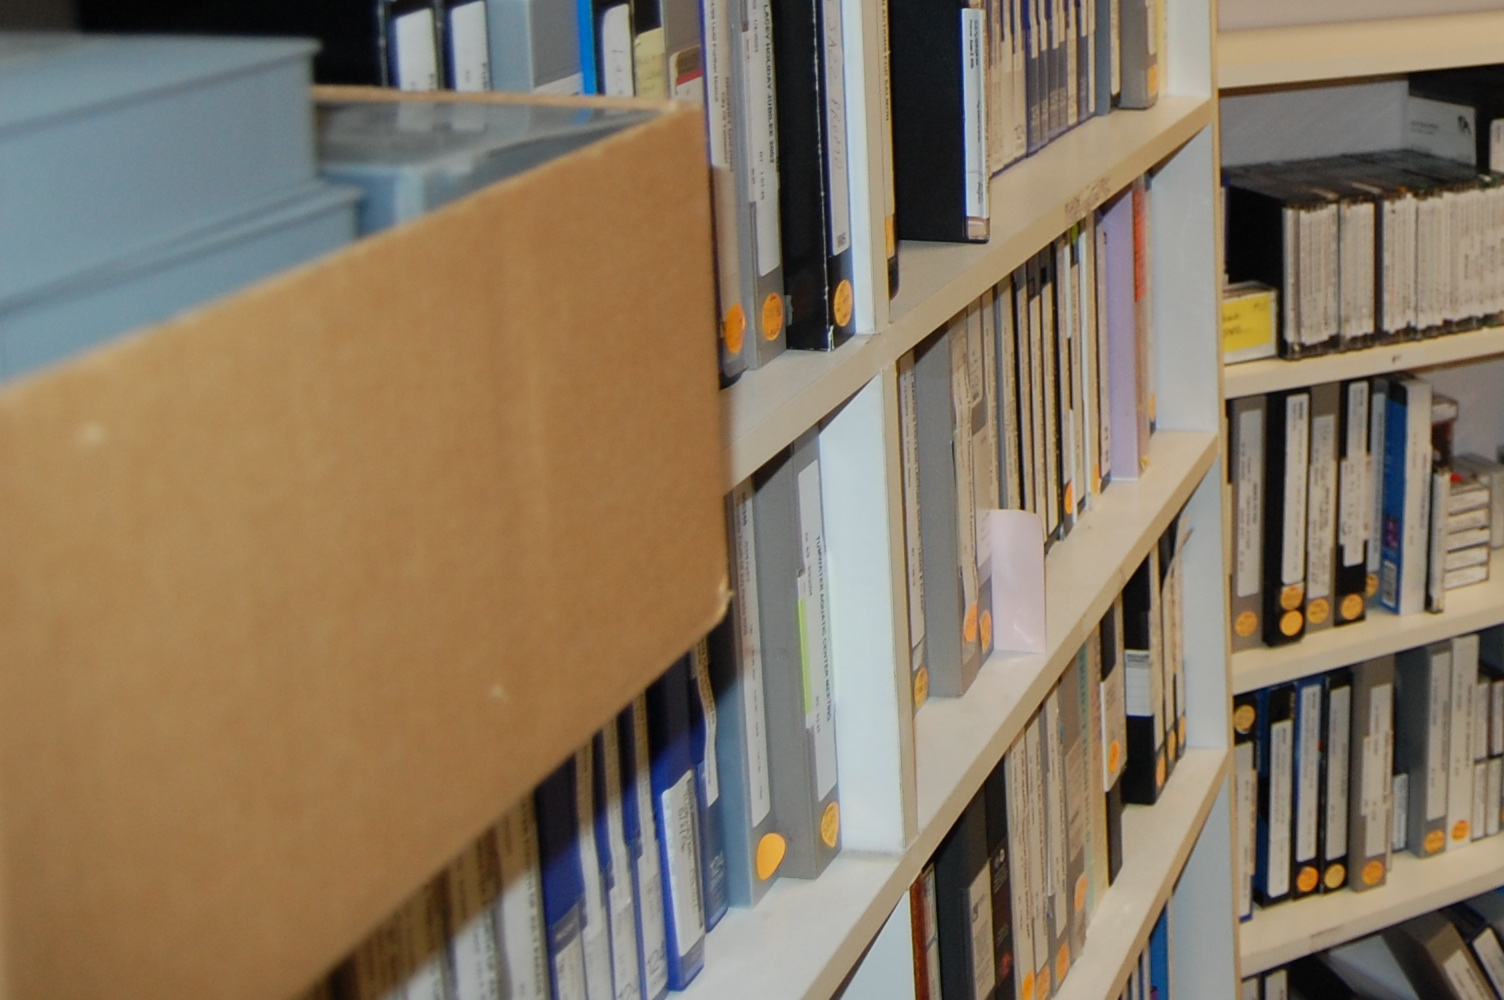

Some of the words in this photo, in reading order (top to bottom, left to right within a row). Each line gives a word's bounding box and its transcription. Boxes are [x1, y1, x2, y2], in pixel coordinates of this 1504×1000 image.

[763, 3, 771, 40] LACEY
[765, 42, 773, 90] HOLIDAY
[767, 93, 775, 137] JUBILEE
[816, 534, 825, 592] TUMWATER
[819, 592, 828, 636] AQUATIC
[824, 678, 832, 722] MEETING
